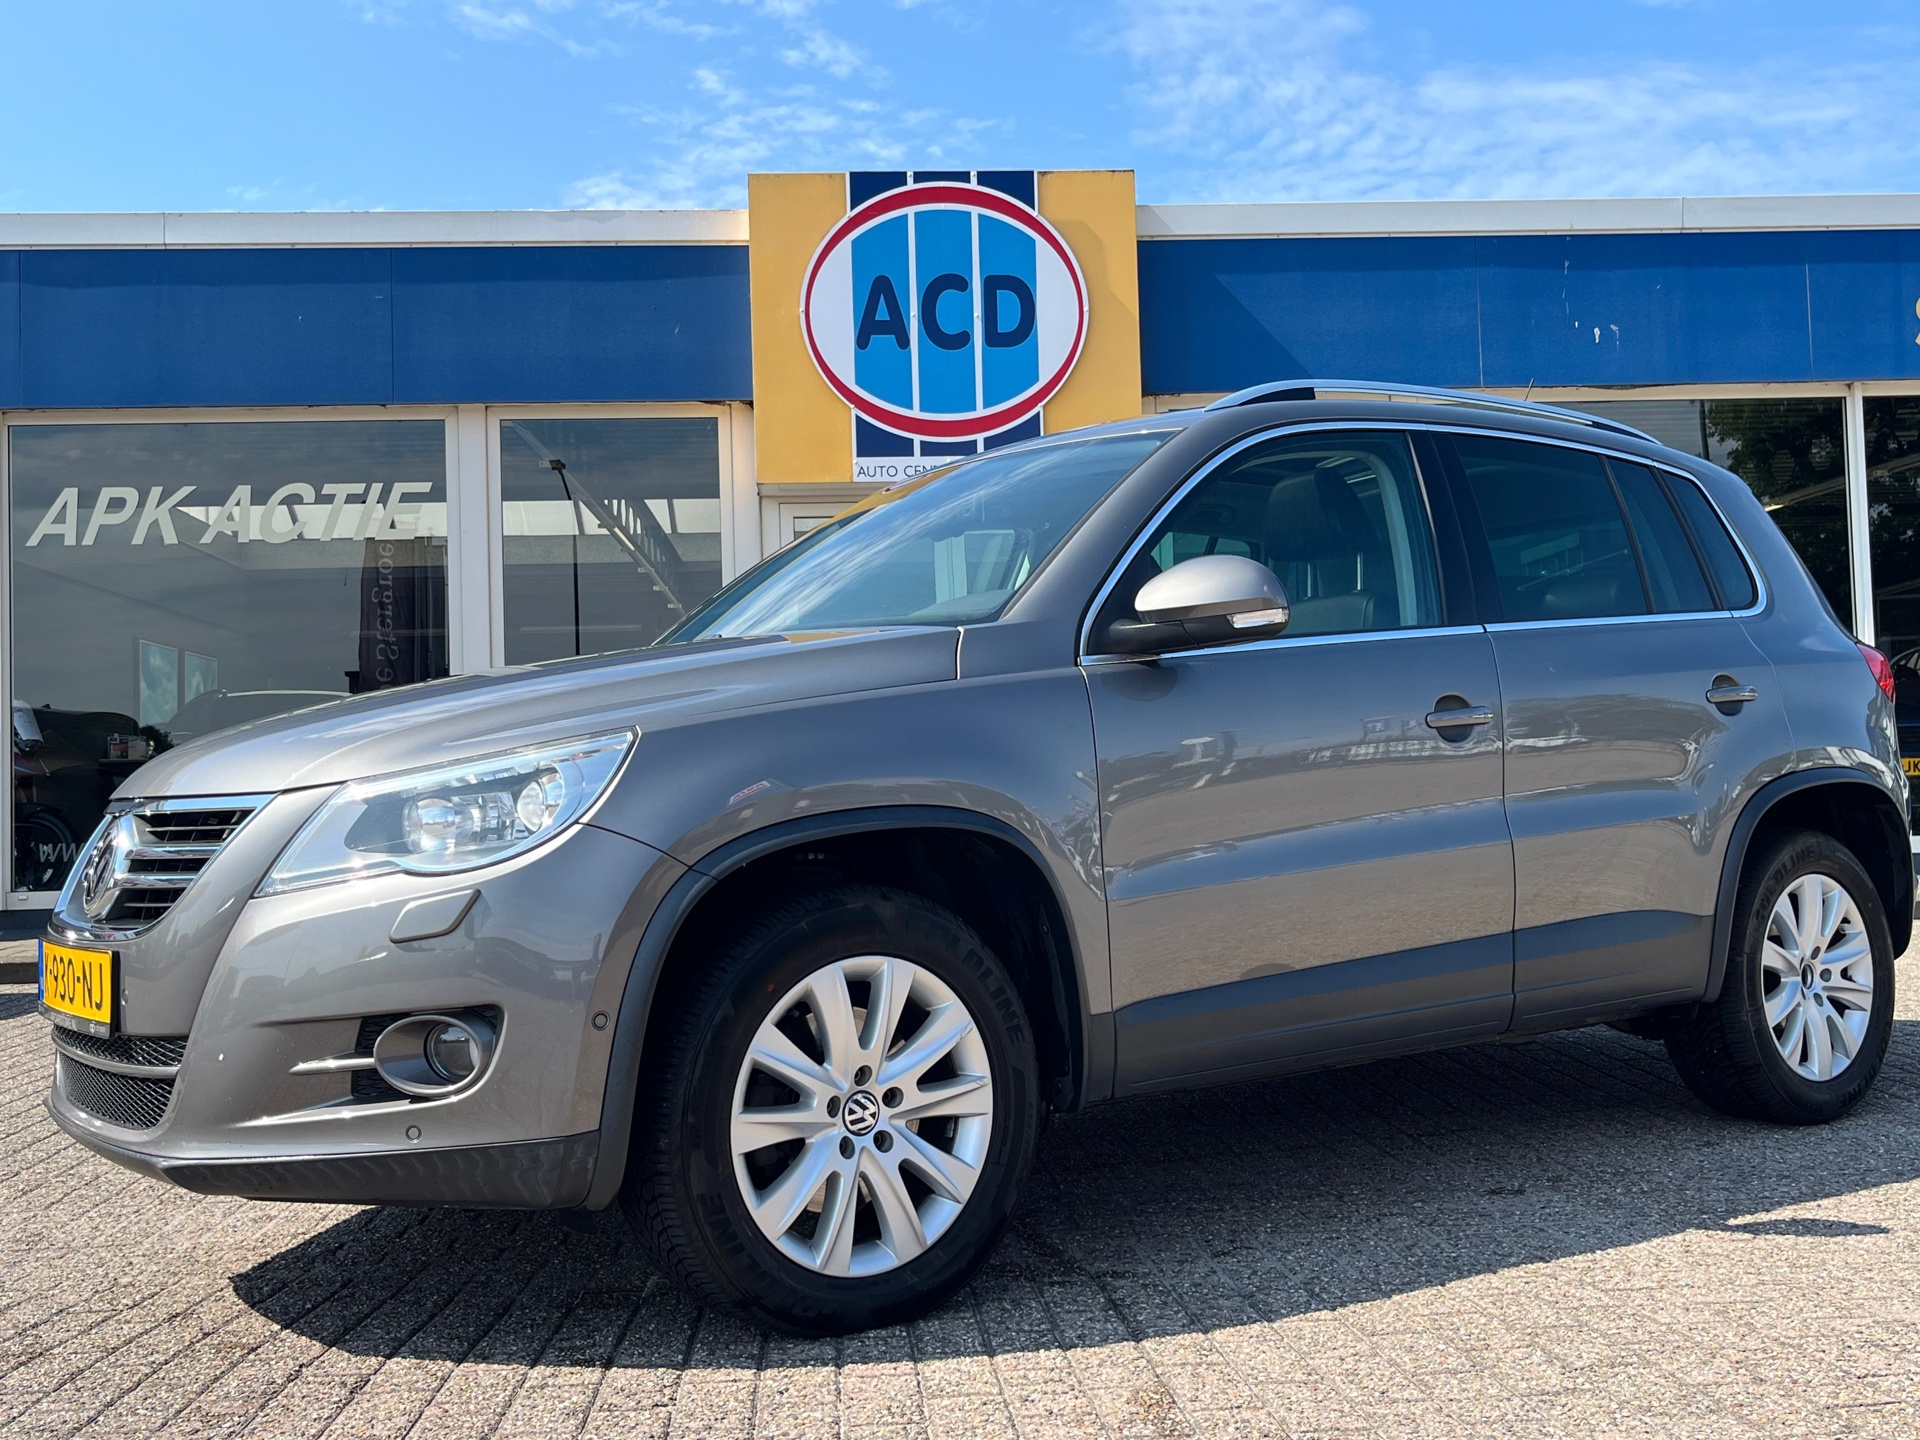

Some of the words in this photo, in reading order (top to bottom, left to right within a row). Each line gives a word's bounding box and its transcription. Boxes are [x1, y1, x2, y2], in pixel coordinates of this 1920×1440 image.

[856, 273, 1036, 351] ACD
[857, 465, 898, 478] AUTO
[26, 485, 197, 546] APK
[200, 482, 433, 544] ACTIE
